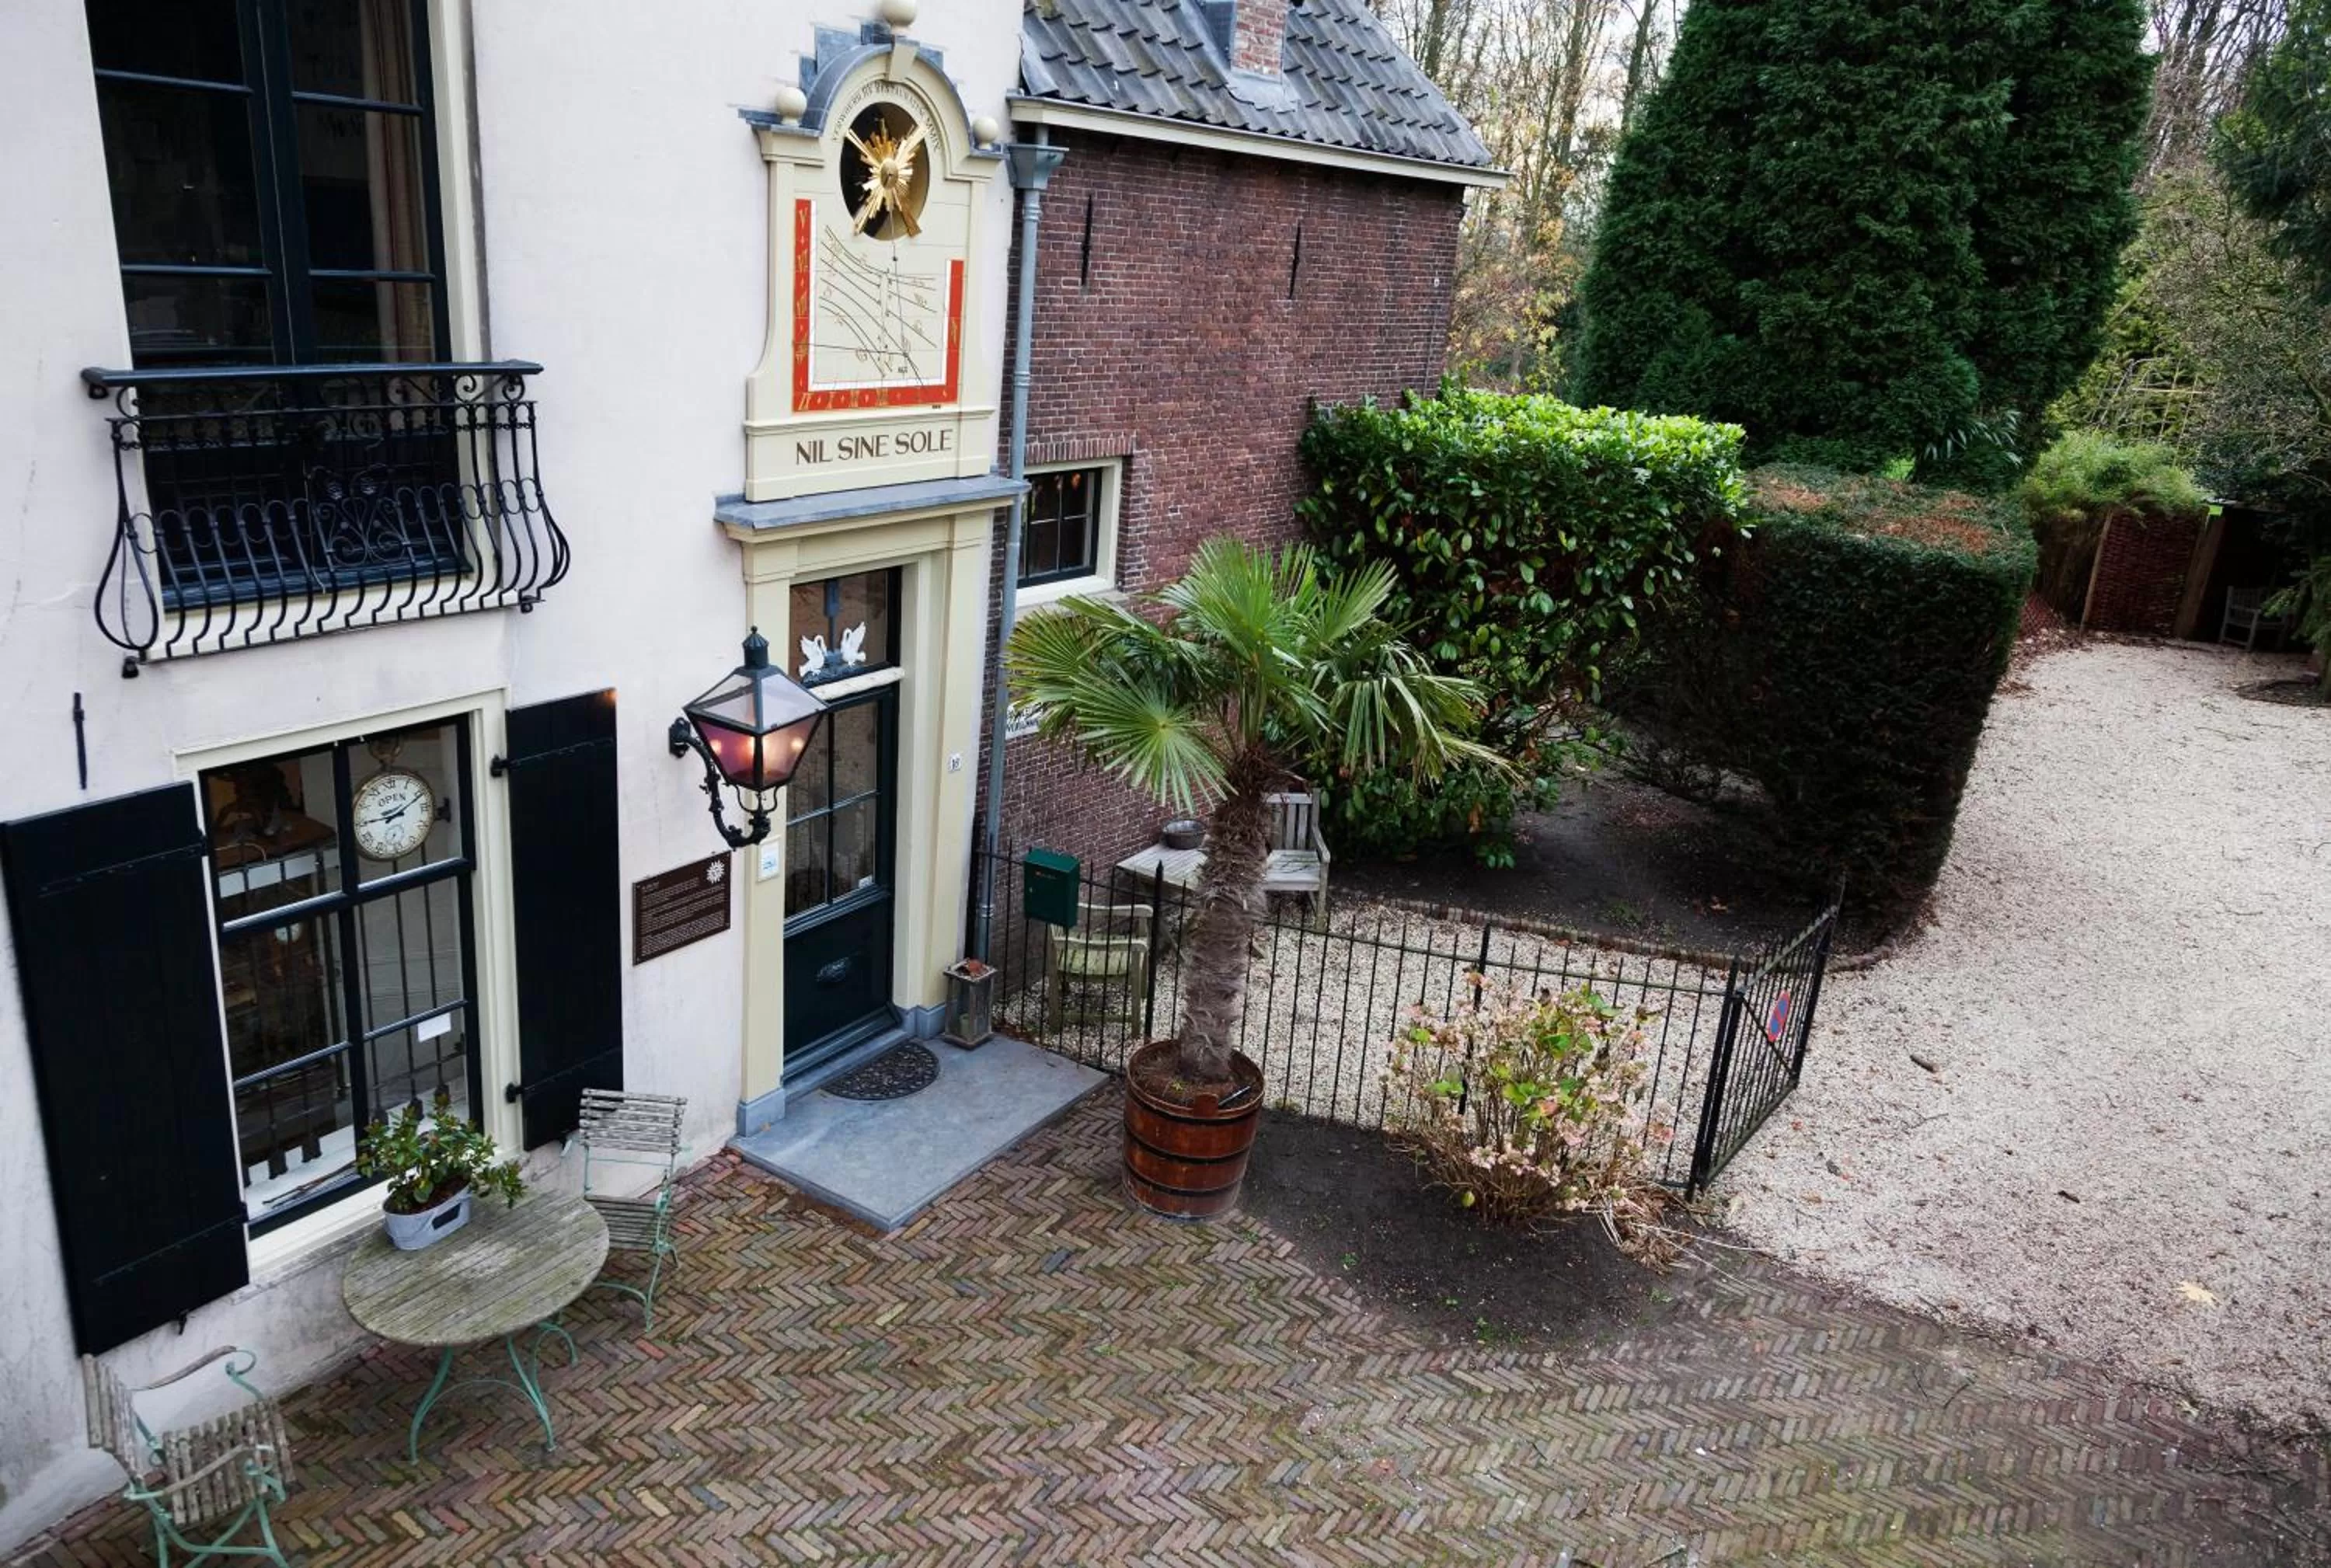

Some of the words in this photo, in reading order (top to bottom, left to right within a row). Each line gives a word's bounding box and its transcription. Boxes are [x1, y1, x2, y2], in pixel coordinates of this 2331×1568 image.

[796, 439, 833, 465] NIL
[837, 434, 890, 461] SINE
[895, 429, 953, 455] SOLE
[378, 793, 406, 807] OPEN
